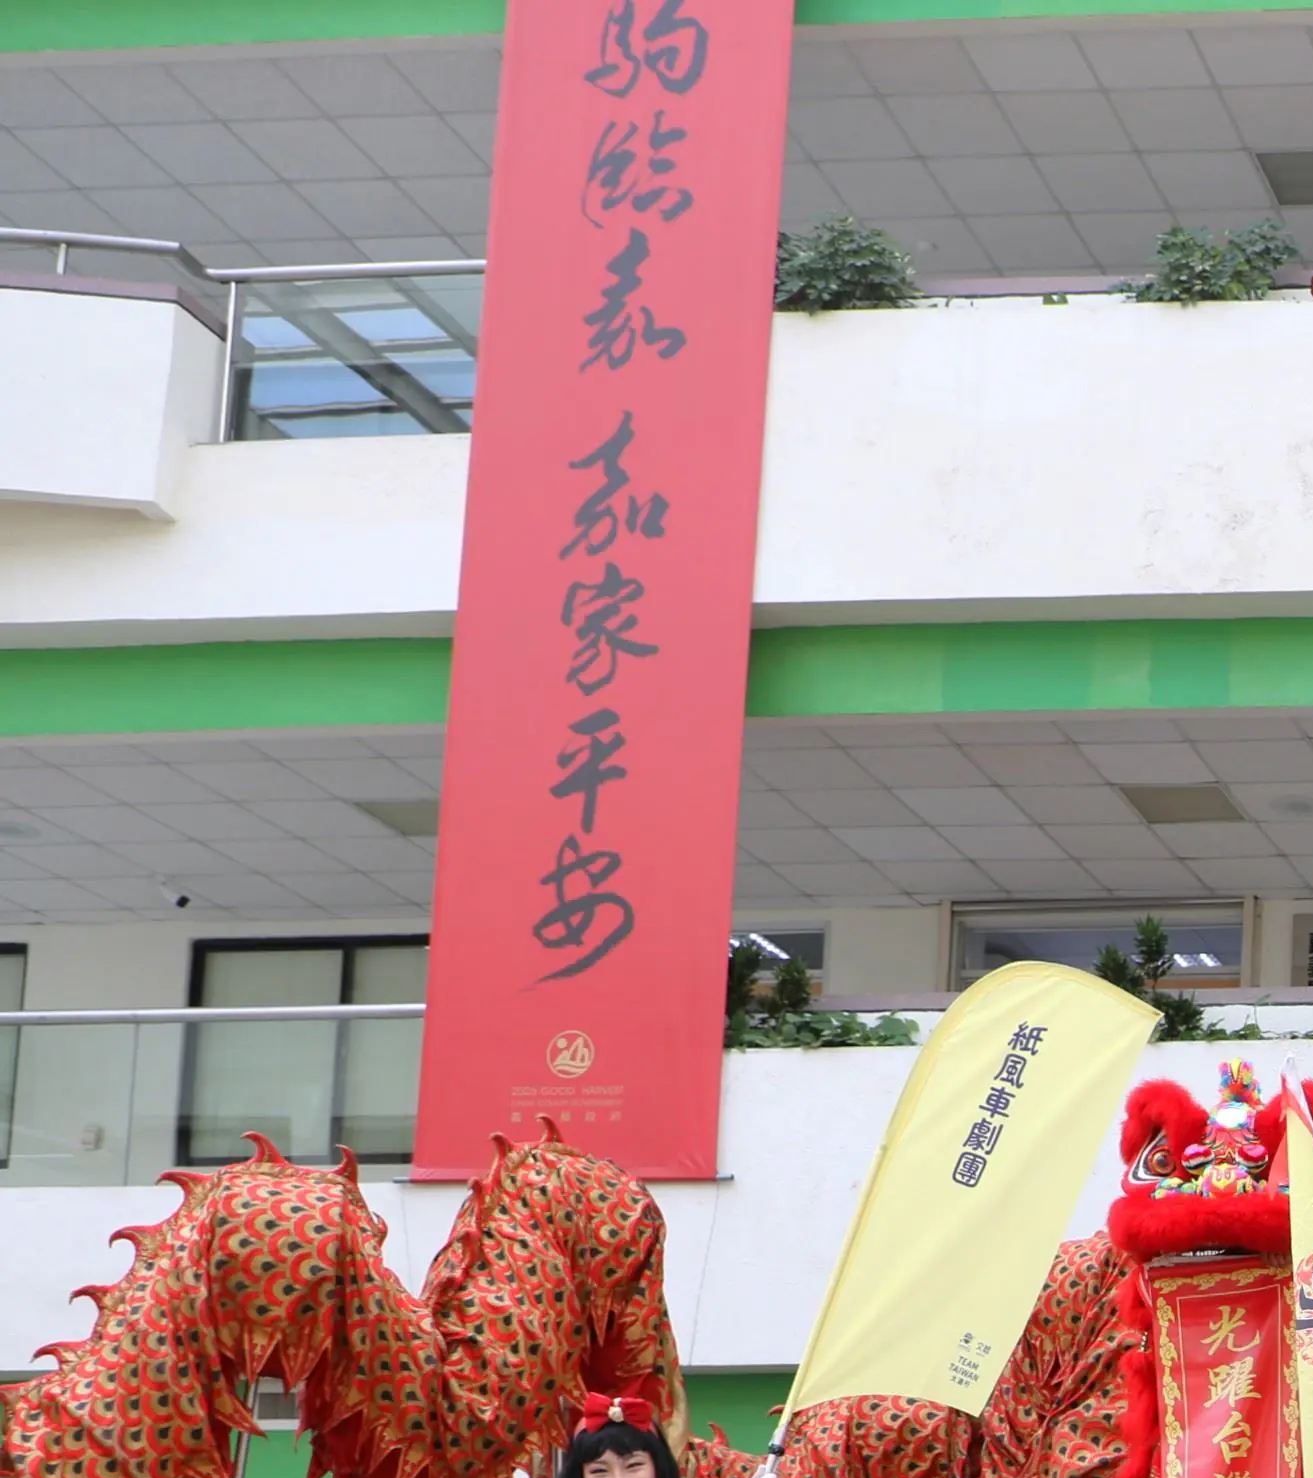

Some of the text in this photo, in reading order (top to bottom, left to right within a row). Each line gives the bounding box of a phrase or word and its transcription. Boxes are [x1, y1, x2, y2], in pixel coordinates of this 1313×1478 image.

[952, 1021, 1048, 1188] 紙風車劇團
